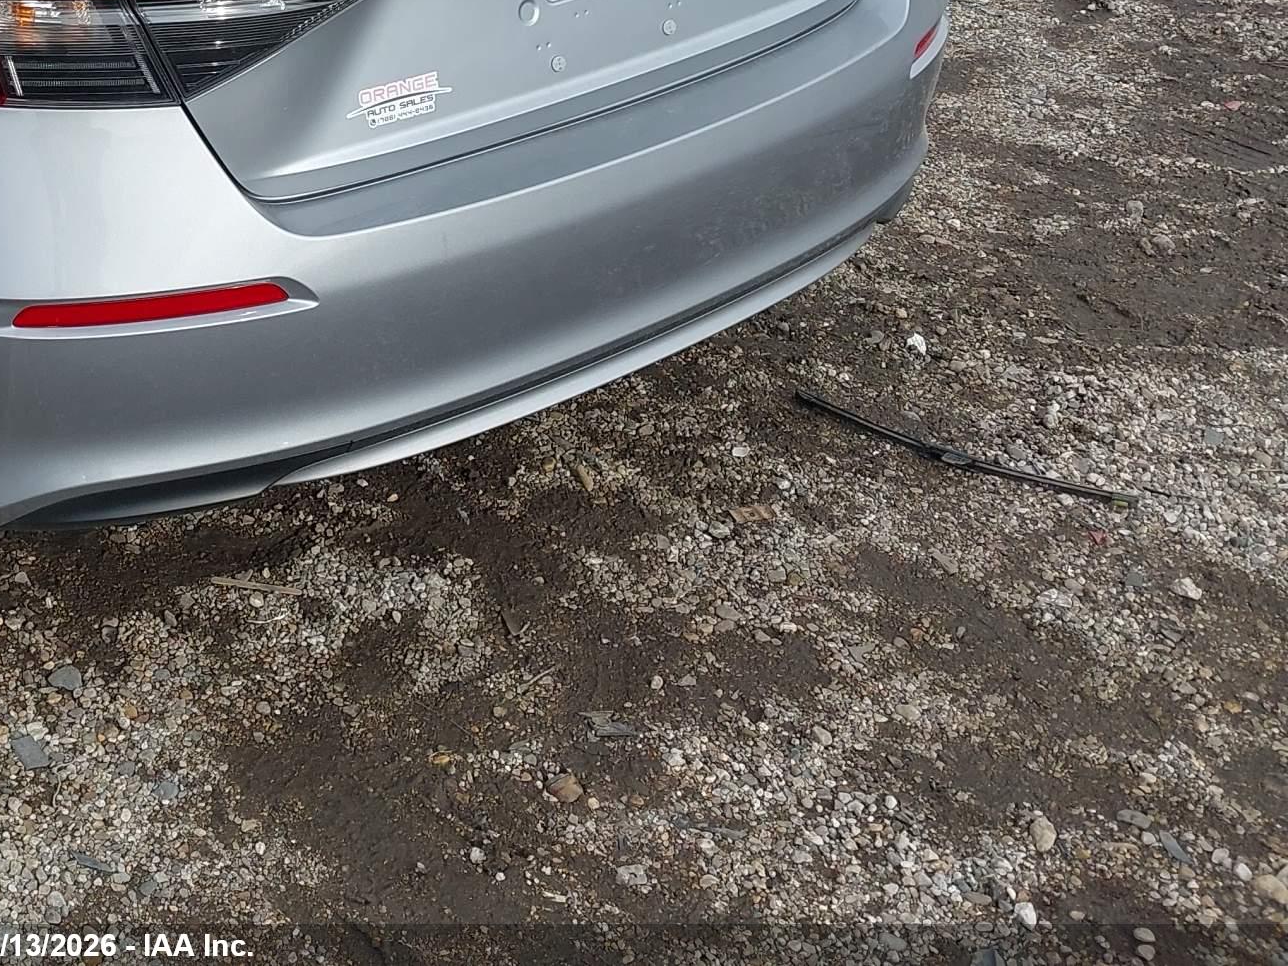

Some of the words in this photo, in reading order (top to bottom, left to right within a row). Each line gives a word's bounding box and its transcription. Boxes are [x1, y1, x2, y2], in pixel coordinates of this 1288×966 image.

[360, 73, 438, 104] ORANGE
[367, 104, 396, 118] AUTO
[399, 94, 434, 110] SALES
